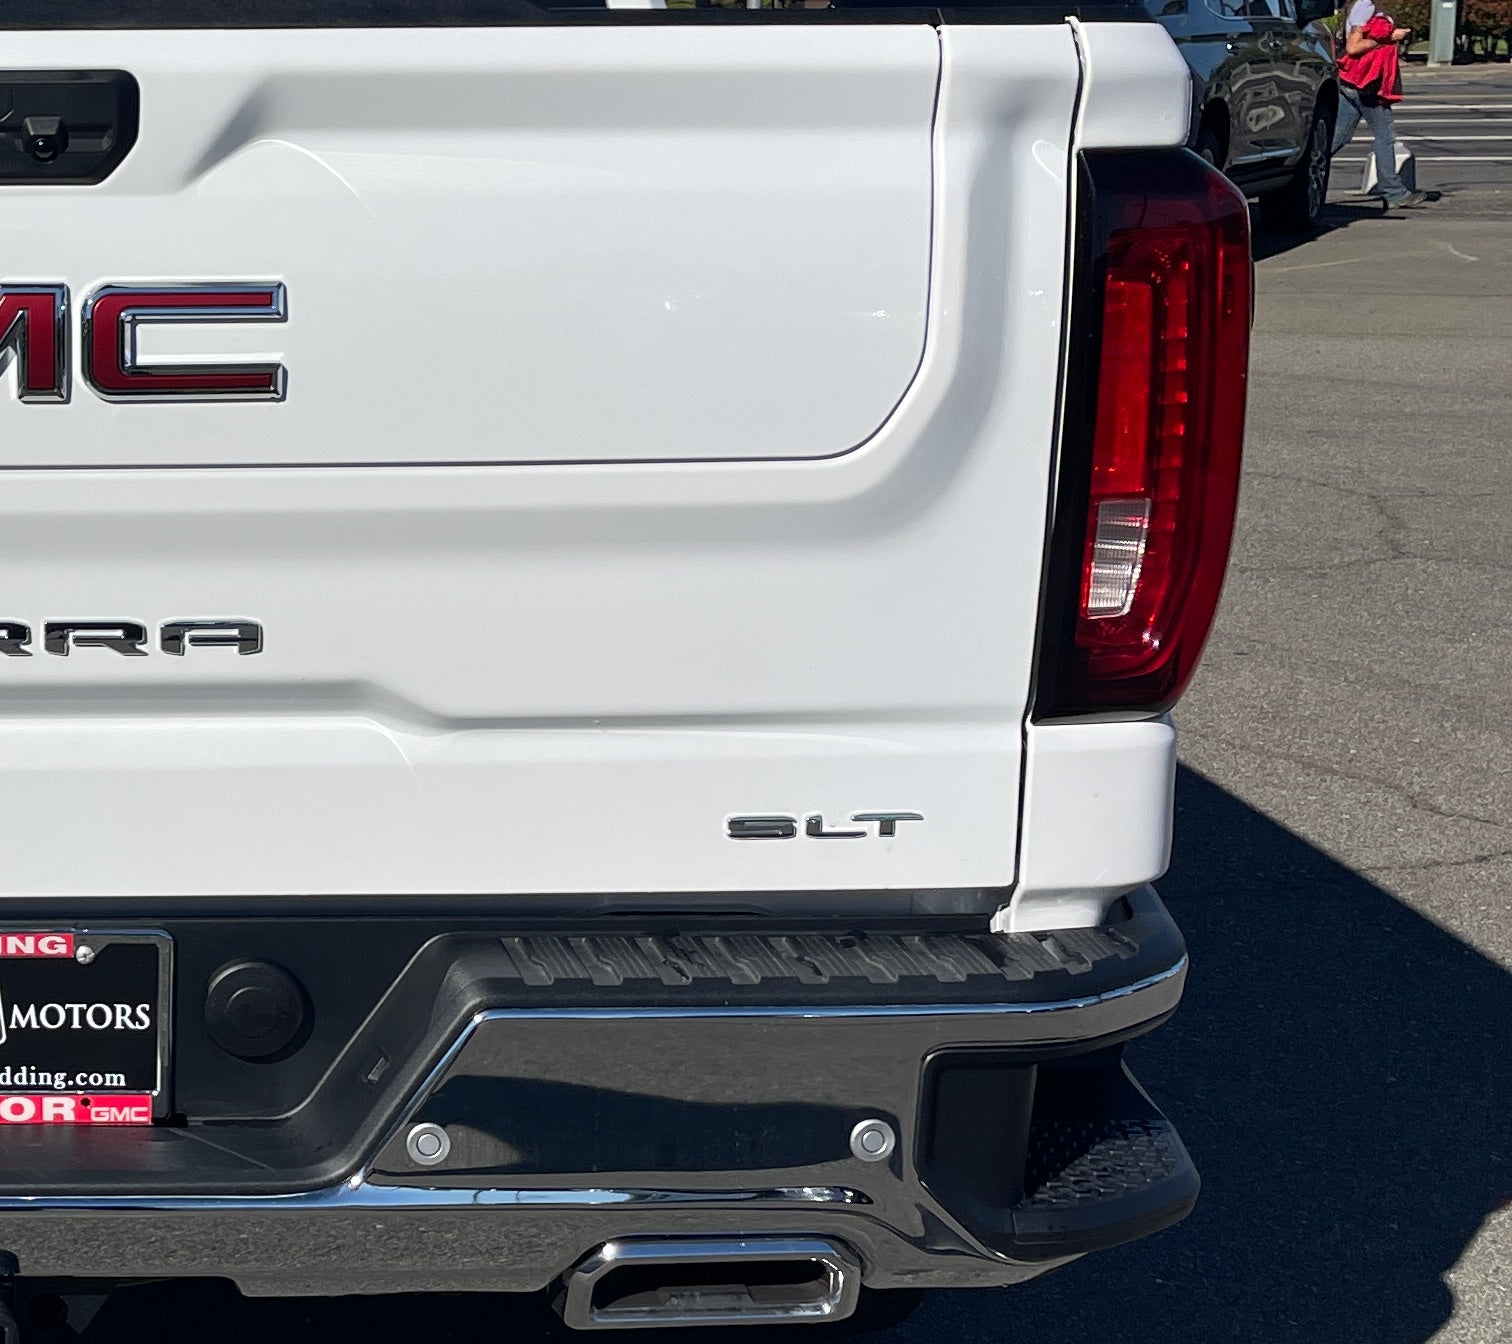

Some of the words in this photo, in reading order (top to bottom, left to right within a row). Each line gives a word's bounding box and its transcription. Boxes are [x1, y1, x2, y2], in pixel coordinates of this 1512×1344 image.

[727, 812, 924, 840] SLT
[9, 1003, 150, 1030] MOTORS
[90, 1106, 149, 1122] GMC
